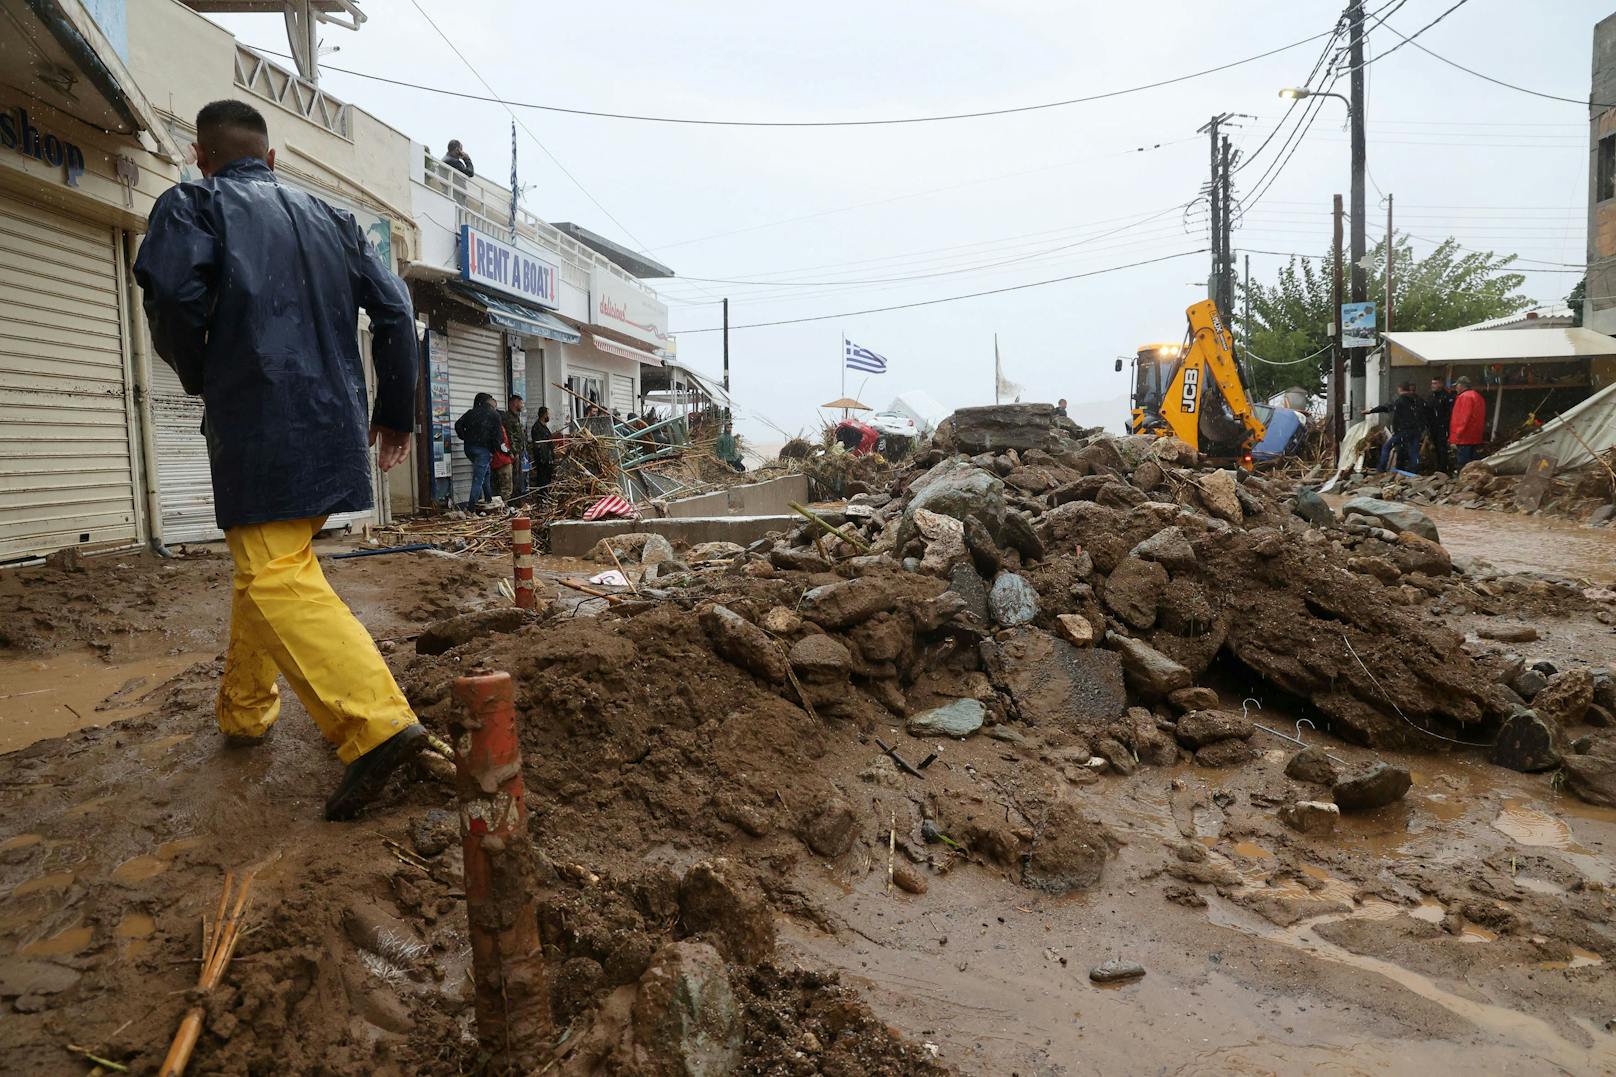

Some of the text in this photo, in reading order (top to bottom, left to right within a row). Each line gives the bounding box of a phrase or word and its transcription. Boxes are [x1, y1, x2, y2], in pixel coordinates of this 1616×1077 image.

[0, 107, 84, 187] shop
[476, 238, 550, 299] RENT A BOAT
[1181, 368, 1199, 413] JCB
